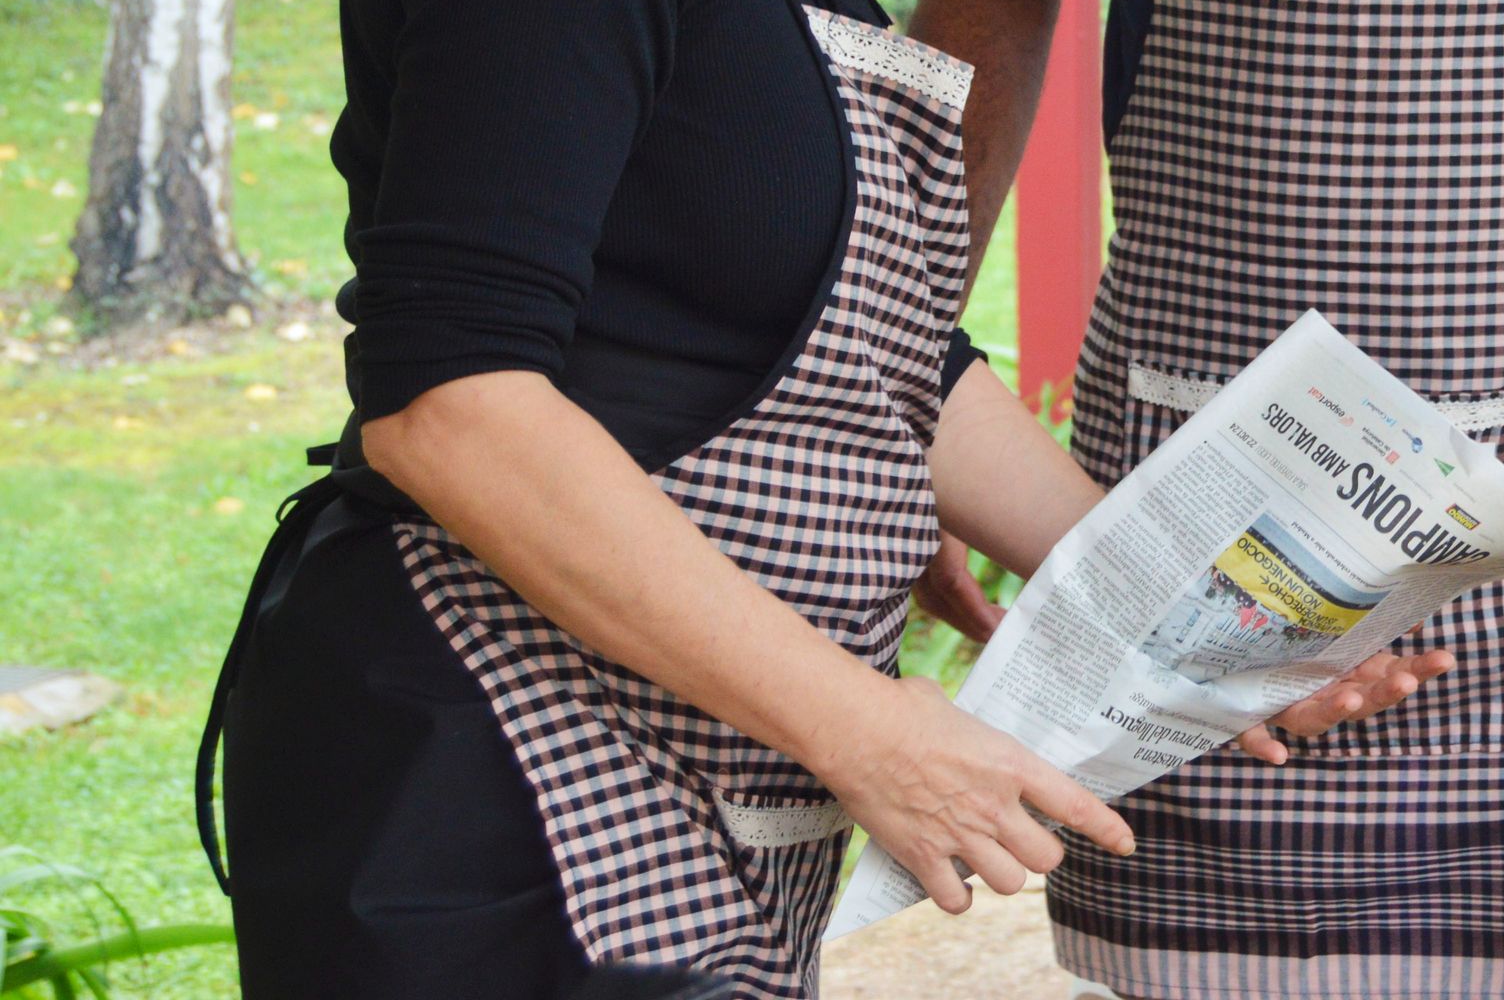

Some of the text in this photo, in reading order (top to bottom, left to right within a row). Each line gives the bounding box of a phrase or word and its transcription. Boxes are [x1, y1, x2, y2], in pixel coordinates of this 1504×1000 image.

[1308, 387, 1345, 418] esportcat
[1261, 403, 1318, 455] VALORS
[1311, 443, 1351, 478] AMB
[1448, 508, 1475, 529] MUNDO
[1236, 537, 1290, 583] NEGOCIO
[1267, 580, 1318, 619] DERECHO
[1284, 577, 1305, 597] UN
[1099, 705, 1153, 741] lloguer
[1146, 723, 1171, 744] del
[1171, 728, 1202, 747] preu
